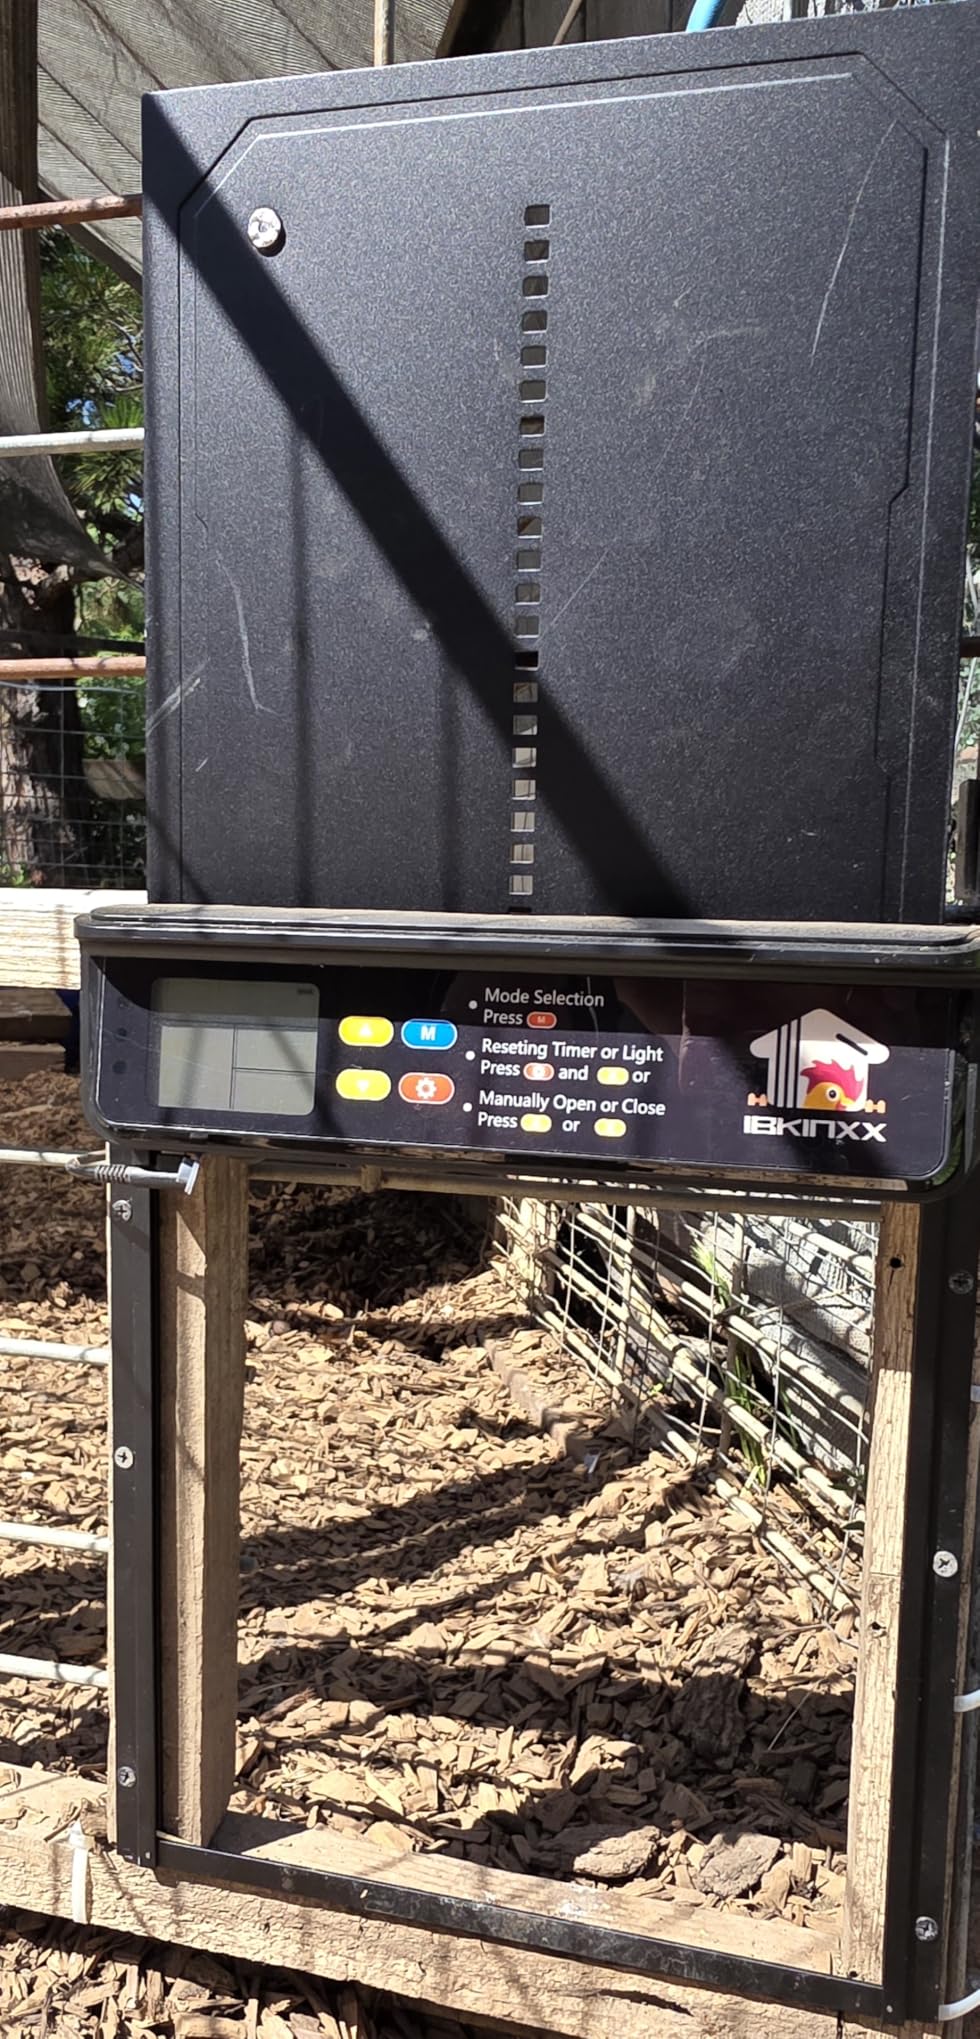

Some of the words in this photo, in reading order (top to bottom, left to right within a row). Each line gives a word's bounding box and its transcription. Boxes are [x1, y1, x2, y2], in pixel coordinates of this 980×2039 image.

[484, 987, 529, 1004] Mode
[534, 989, 605, 1007] Selection
[483, 1009, 523, 1025] Press
[420, 1026, 436, 1041] M
[481, 1038, 548, 1059] Reseting
[552, 1041, 597, 1059] Timer
[600, 1046, 619, 1059] or
[622, 1044, 664, 1064] Light
[480, 1060, 520, 1076] Press
[558, 1066, 589, 1081] and
[632, 1071, 651, 1084] or
[479, 1090, 550, 1112] Manually
[553, 1094, 596, 1113] Open
[600, 1099, 619, 1113] or
[621, 1098, 666, 1116] Close
[477, 1112, 518, 1129] Press
[562, 1119, 581, 1133] or
